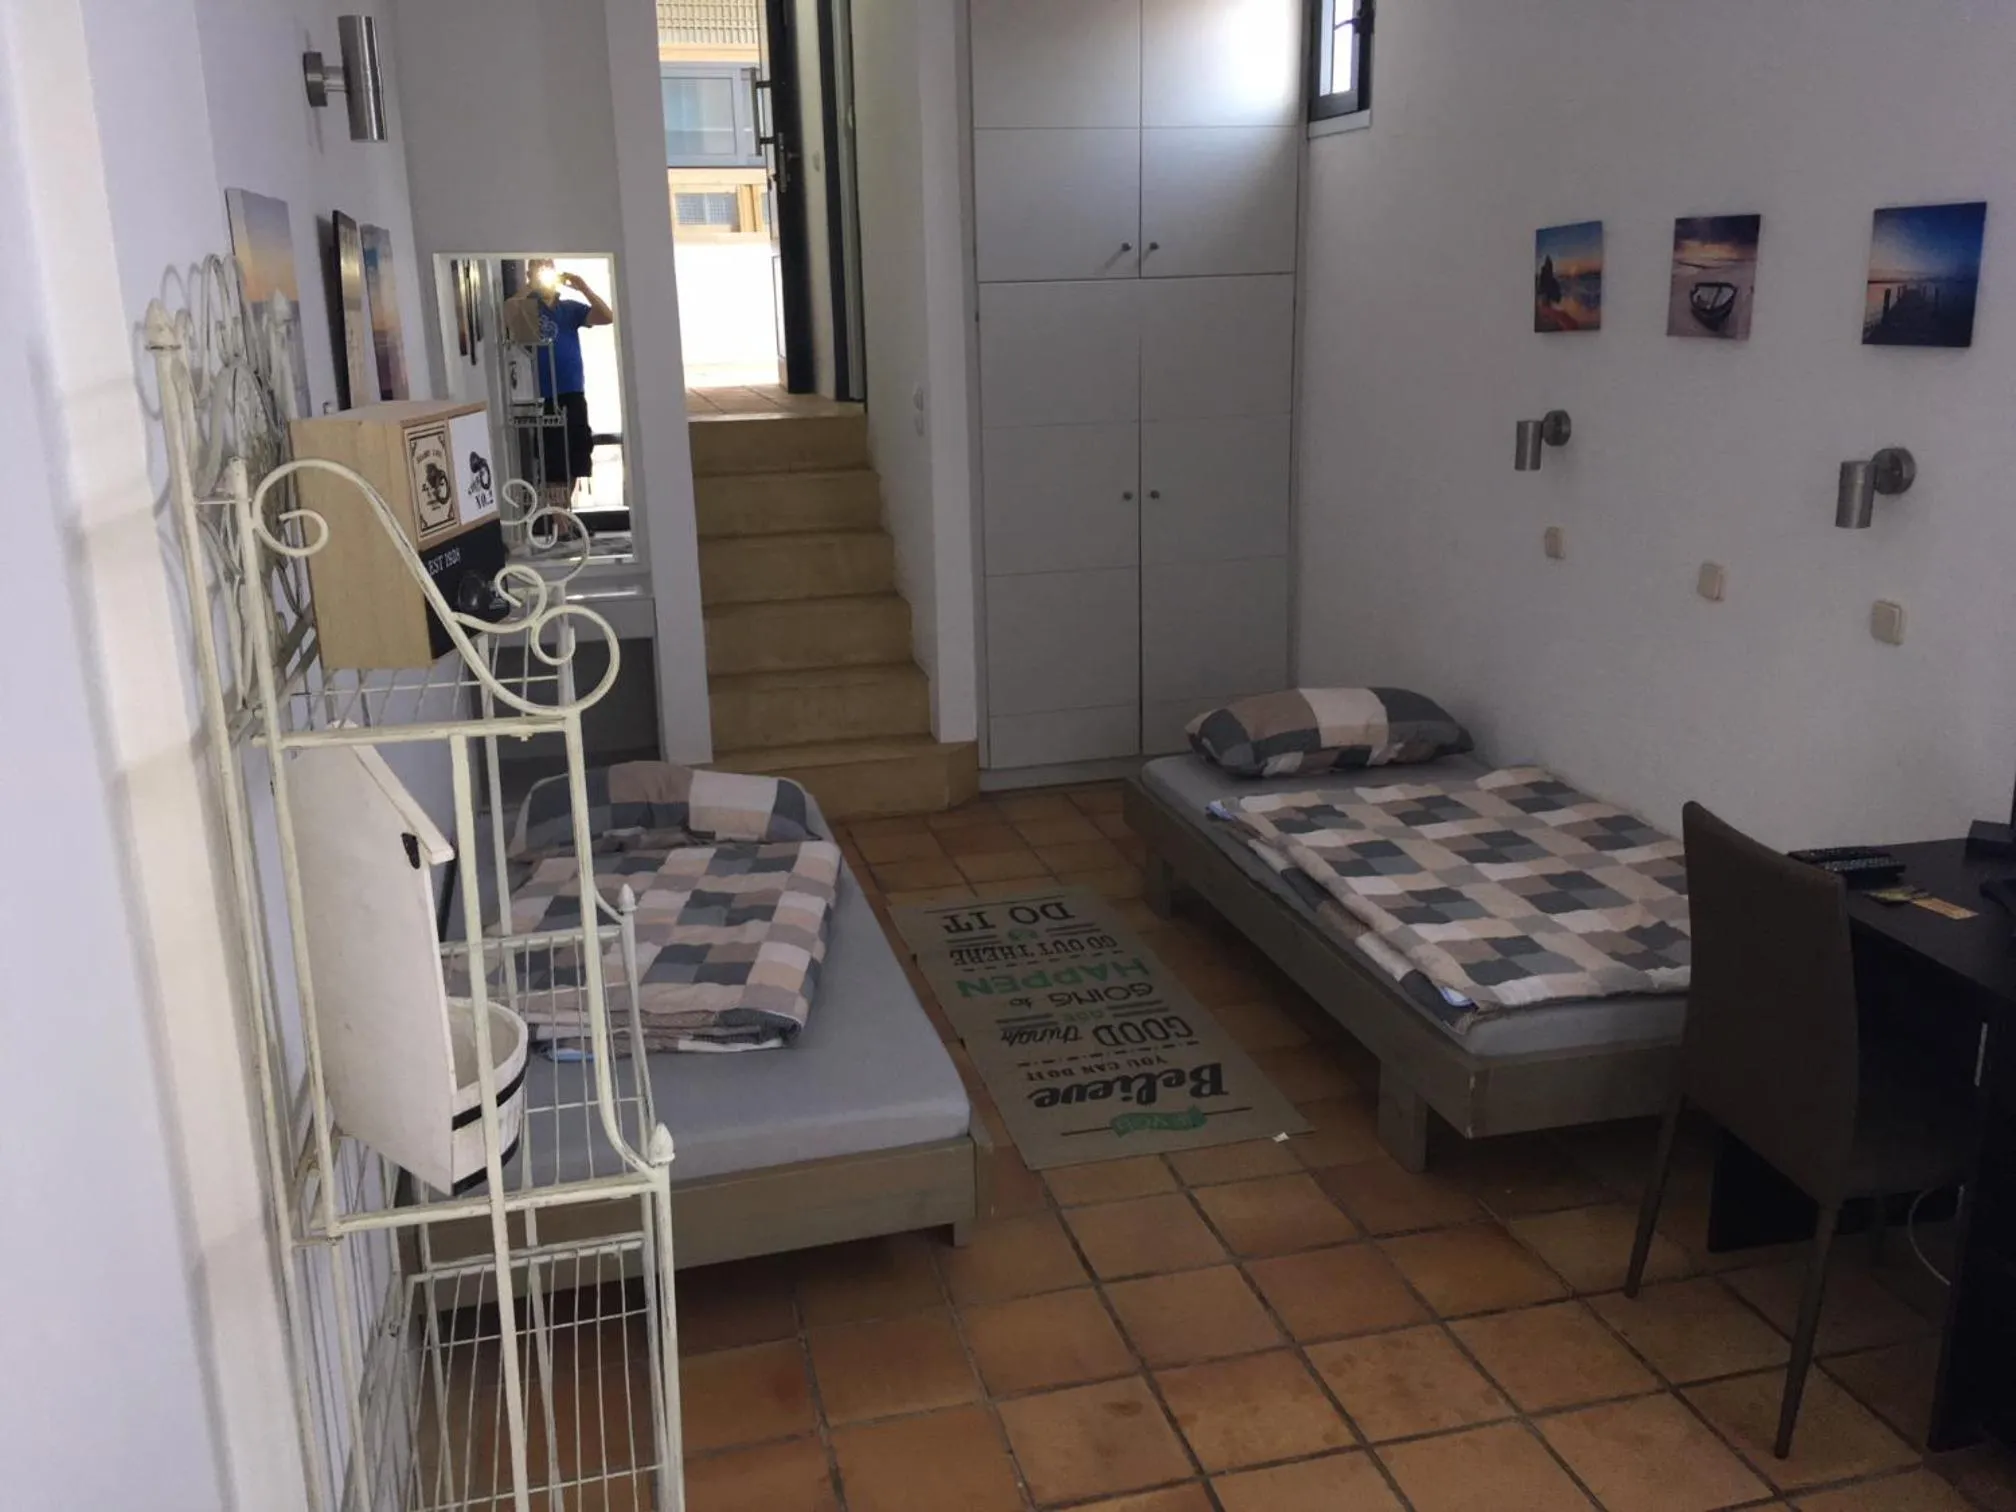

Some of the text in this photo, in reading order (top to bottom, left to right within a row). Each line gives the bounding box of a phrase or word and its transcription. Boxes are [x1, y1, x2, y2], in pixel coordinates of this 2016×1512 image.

[942, 911, 997, 935] IT
[1009, 901, 1076, 926] DO
[949, 934, 1119, 967] GO OUT THERE
[957, 958, 1150, 998] HAPPEN
[1048, 982, 1154, 1009] GOING
[1092, 1015, 1194, 1047] GOOD
[1081, 1060, 1121, 1076] CAN
[1123, 1056, 1168, 1071] YOU
[1026, 1061, 1229, 1108] Believe
